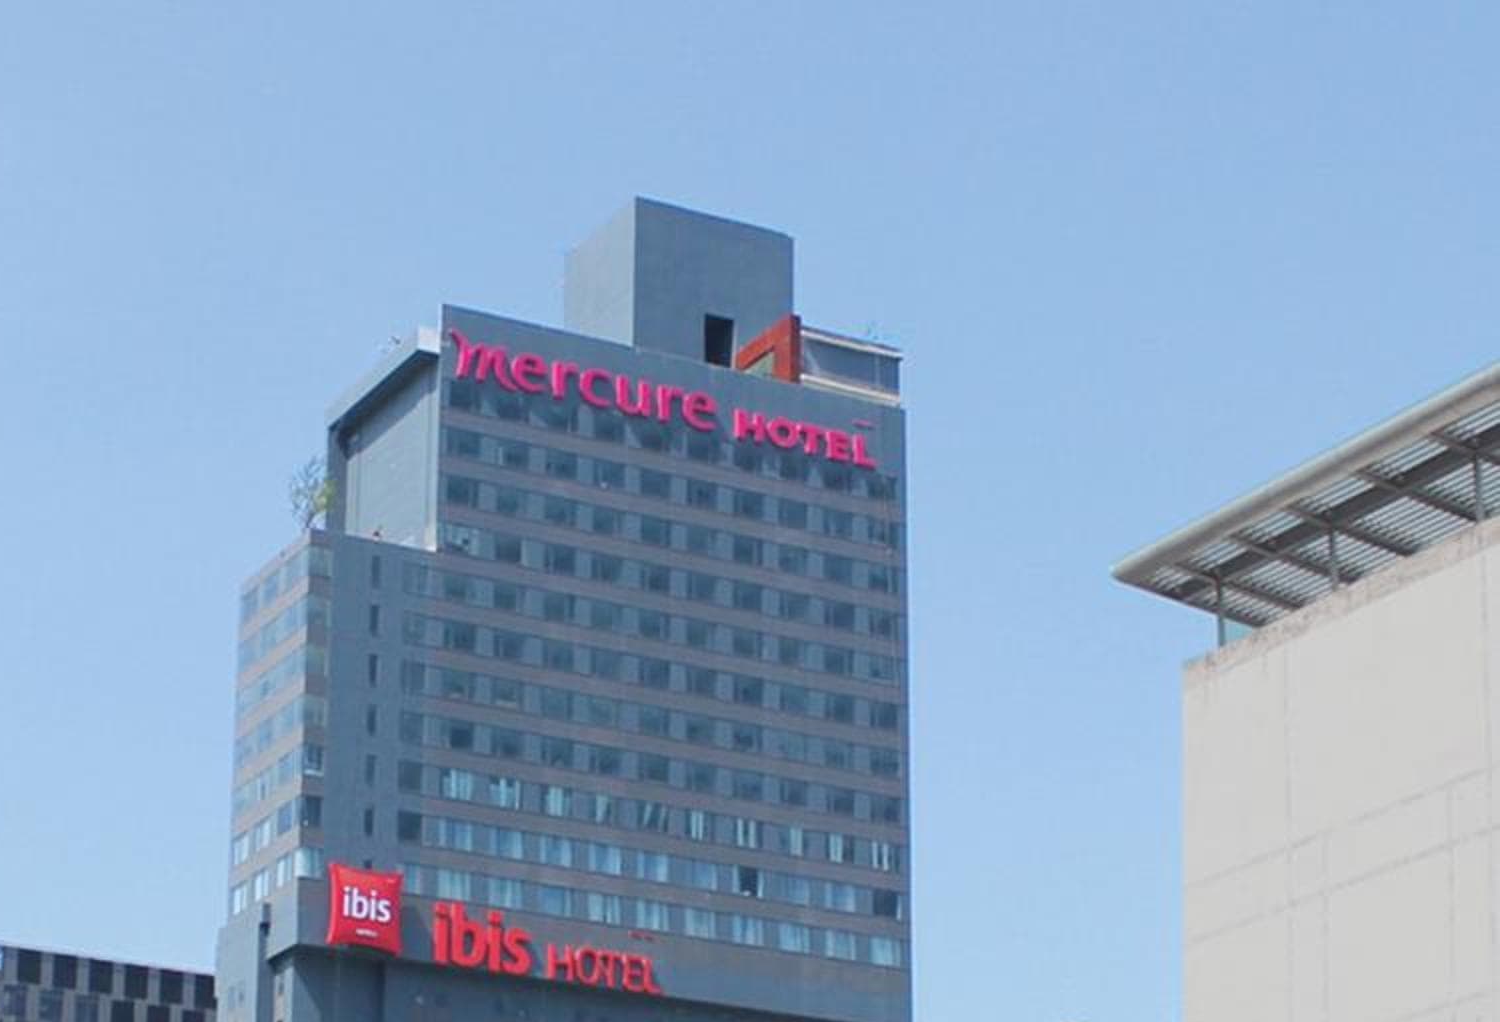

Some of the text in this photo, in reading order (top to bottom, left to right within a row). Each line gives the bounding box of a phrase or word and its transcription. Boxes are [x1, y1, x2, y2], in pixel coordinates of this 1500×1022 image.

[732, 408, 878, 471] HOTEL
[342, 885, 392, 923] ibis
[432, 901, 663, 996] ibis HOTEL
